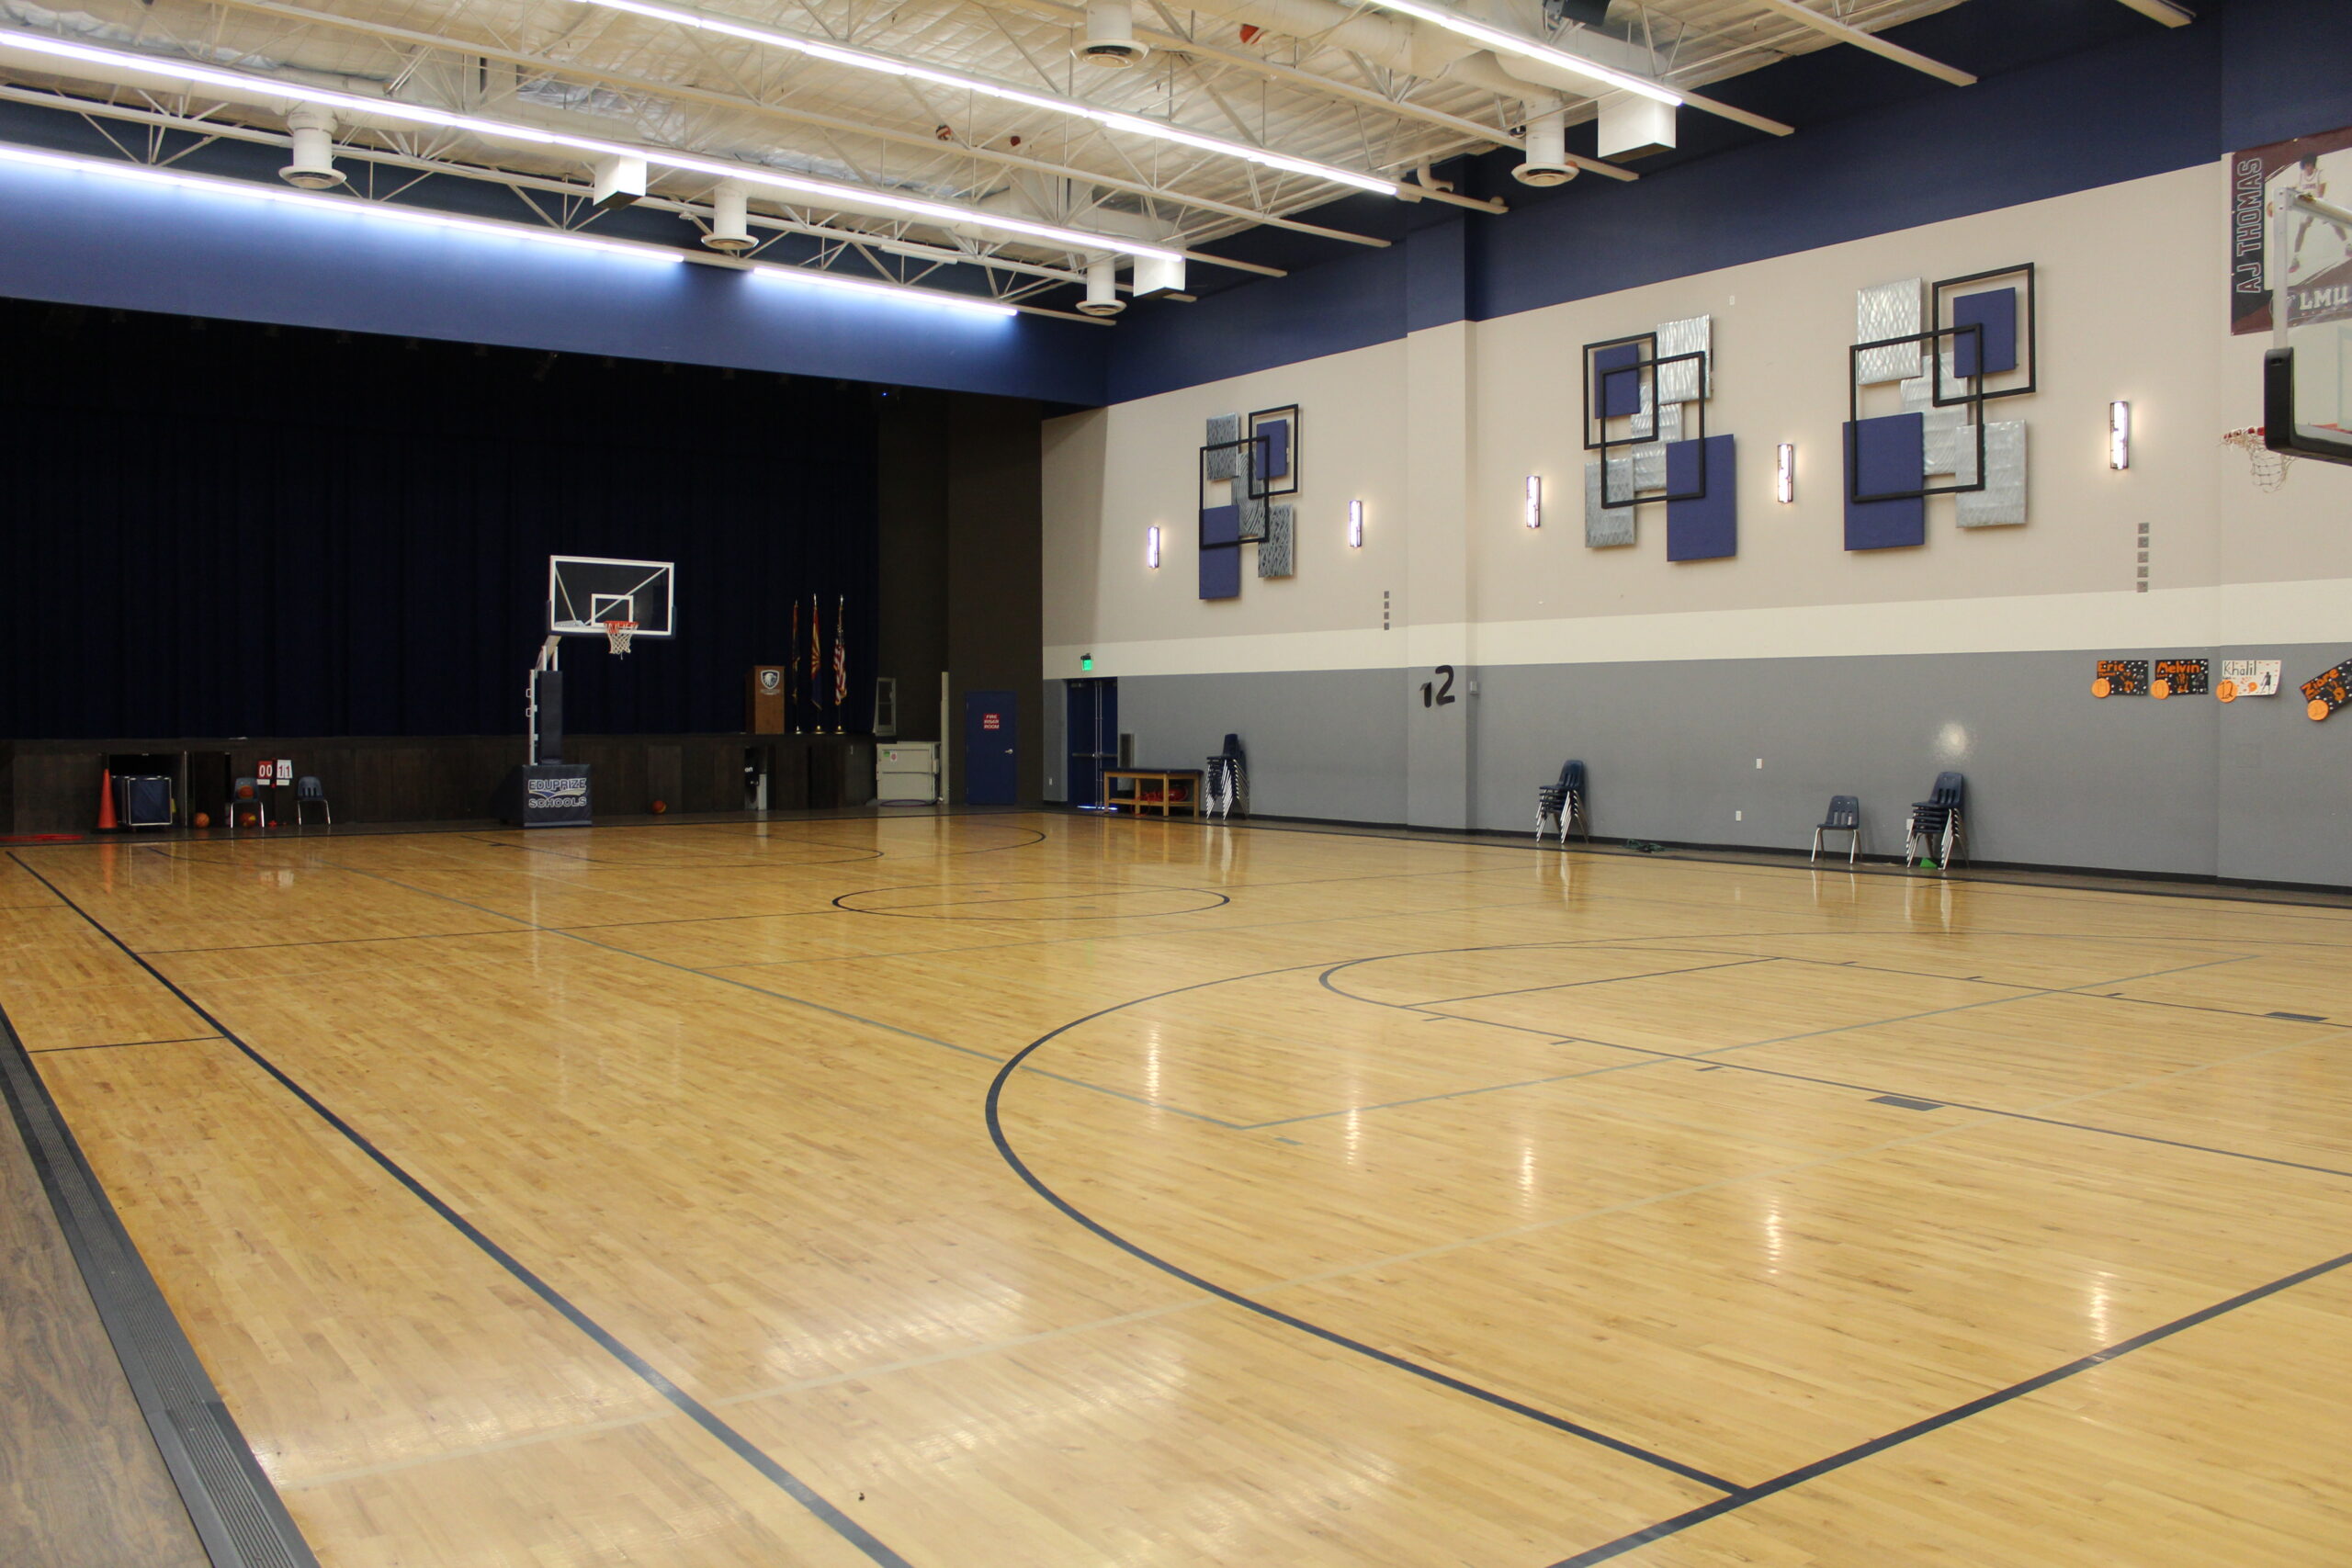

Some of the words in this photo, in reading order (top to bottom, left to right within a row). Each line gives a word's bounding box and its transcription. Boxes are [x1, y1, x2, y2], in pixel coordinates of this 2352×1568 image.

[2236, 157, 2262, 256] THOMAS
[2236, 262, 2262, 294] AJ
[2299, 286, 2349, 310] LMU
[2097, 660, 2126, 672] Eric
[2155, 660, 2201, 674] Melvin
[2223, 660, 2257, 676] Khalil
[1419, 664, 1455, 708] 12
[2220, 680, 2233, 699] 12
[259, 764, 273, 777] 00
[278, 765, 290, 778] 11
[528, 778, 587, 791] EDUPRIZE
[528, 796, 587, 808] SCHOOLS
